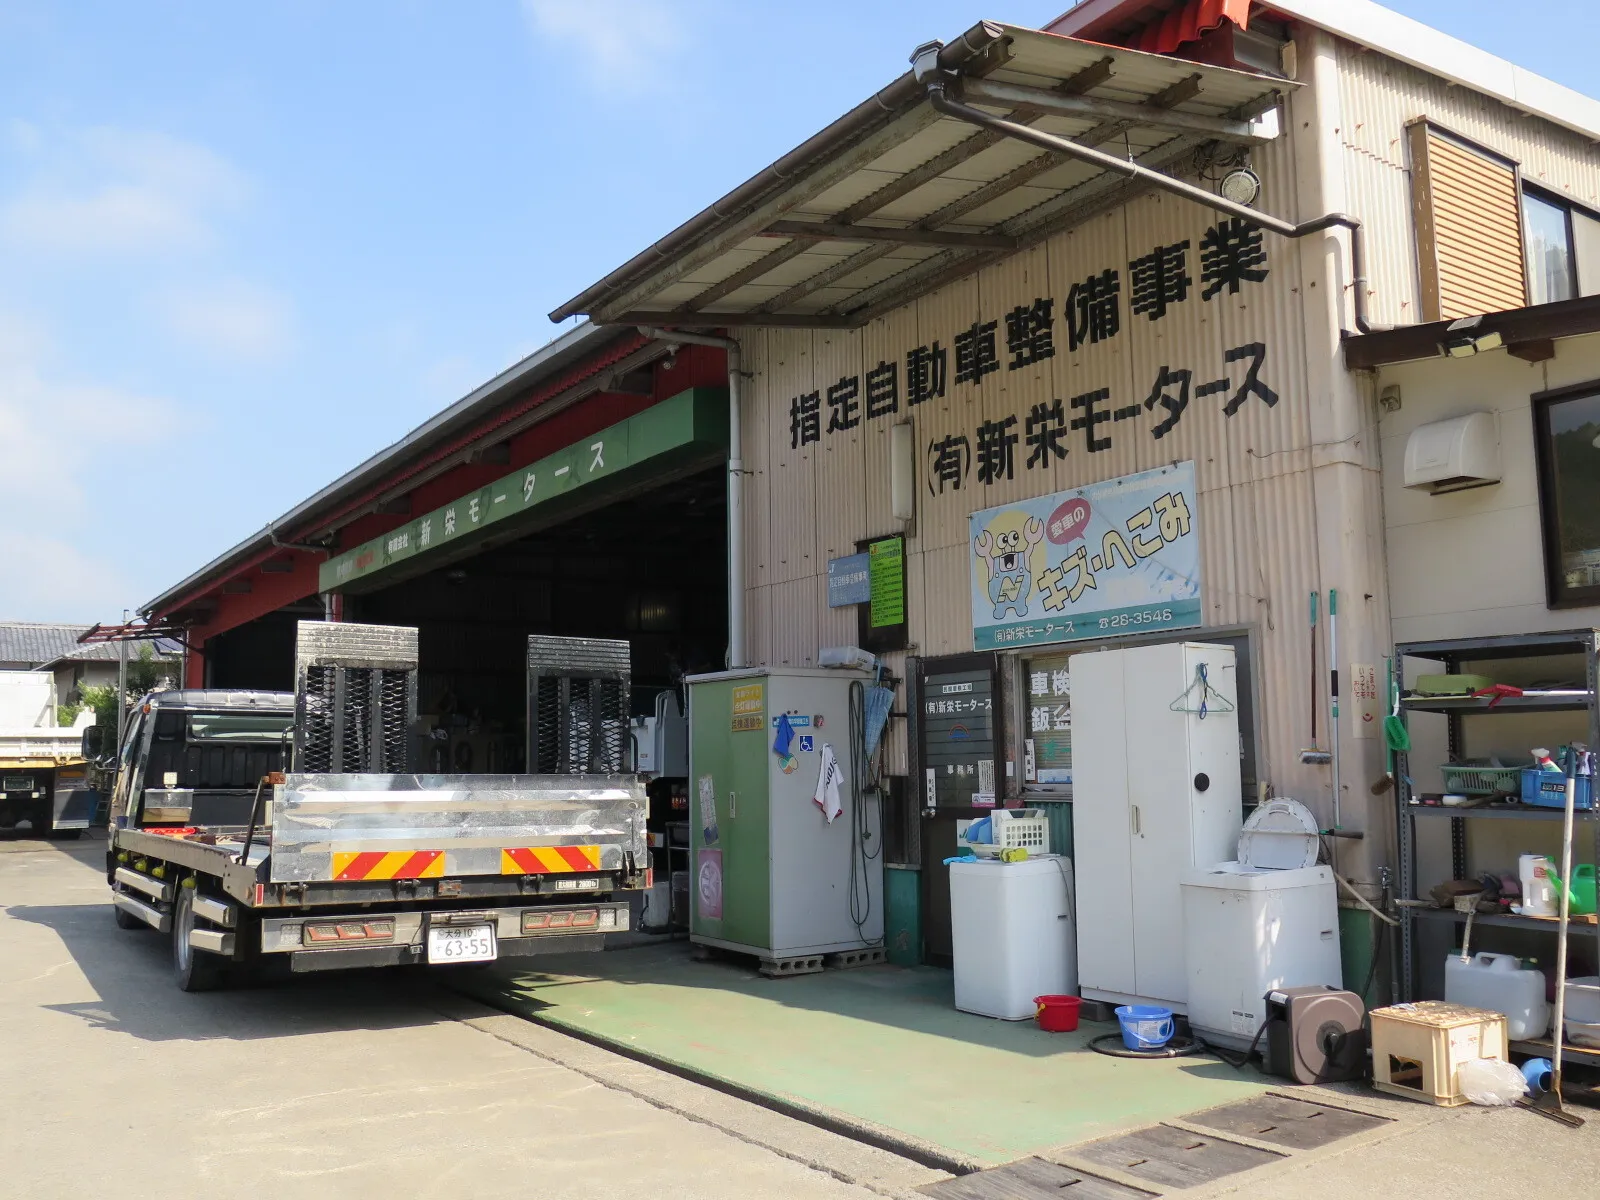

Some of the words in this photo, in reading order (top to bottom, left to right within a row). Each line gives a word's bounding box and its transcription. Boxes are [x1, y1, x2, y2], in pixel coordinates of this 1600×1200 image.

[789, 217, 1270, 450] 指定自動車整備事業
[1049, 505, 1086, 537] 愛車の
[1037, 491, 1192, 612] キズ・へこみ
[1030, 670, 1070, 697] 車検
[947, 764, 974, 775] 事務所
